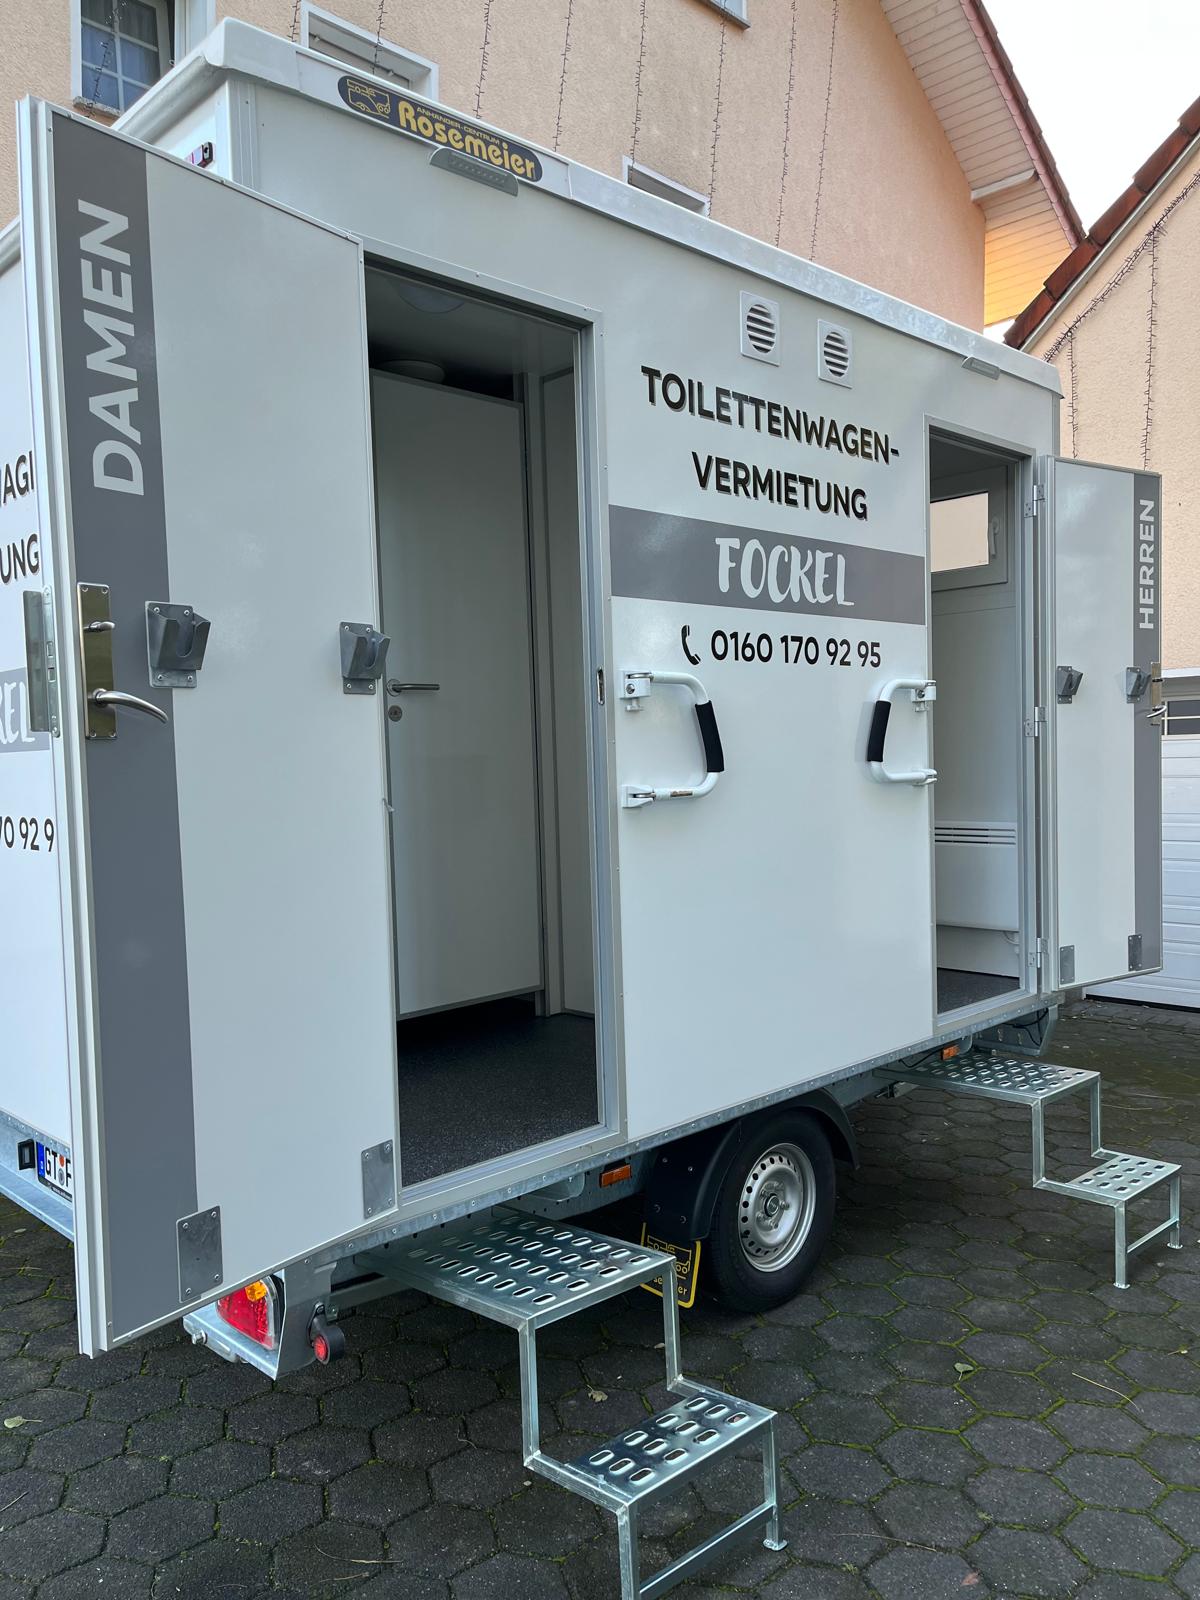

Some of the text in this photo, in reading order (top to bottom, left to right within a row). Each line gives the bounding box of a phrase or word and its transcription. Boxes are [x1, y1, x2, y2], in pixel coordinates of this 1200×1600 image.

[397, 100, 537, 179] Rosemeier
[77, 198, 145, 497] DAMEN
[641, 365, 900, 464] TOILETTENWAGEN-
[692, 451, 868, 520] VERMIETUNG
[714, 537, 855, 606] FOCKEL
[1139, 499, 1155, 630] HERREN
[710, 629, 882, 669] 0160 170 92 95
[19, 816, 40, 851] 92
[44, 1146, 58, 1181] GT
